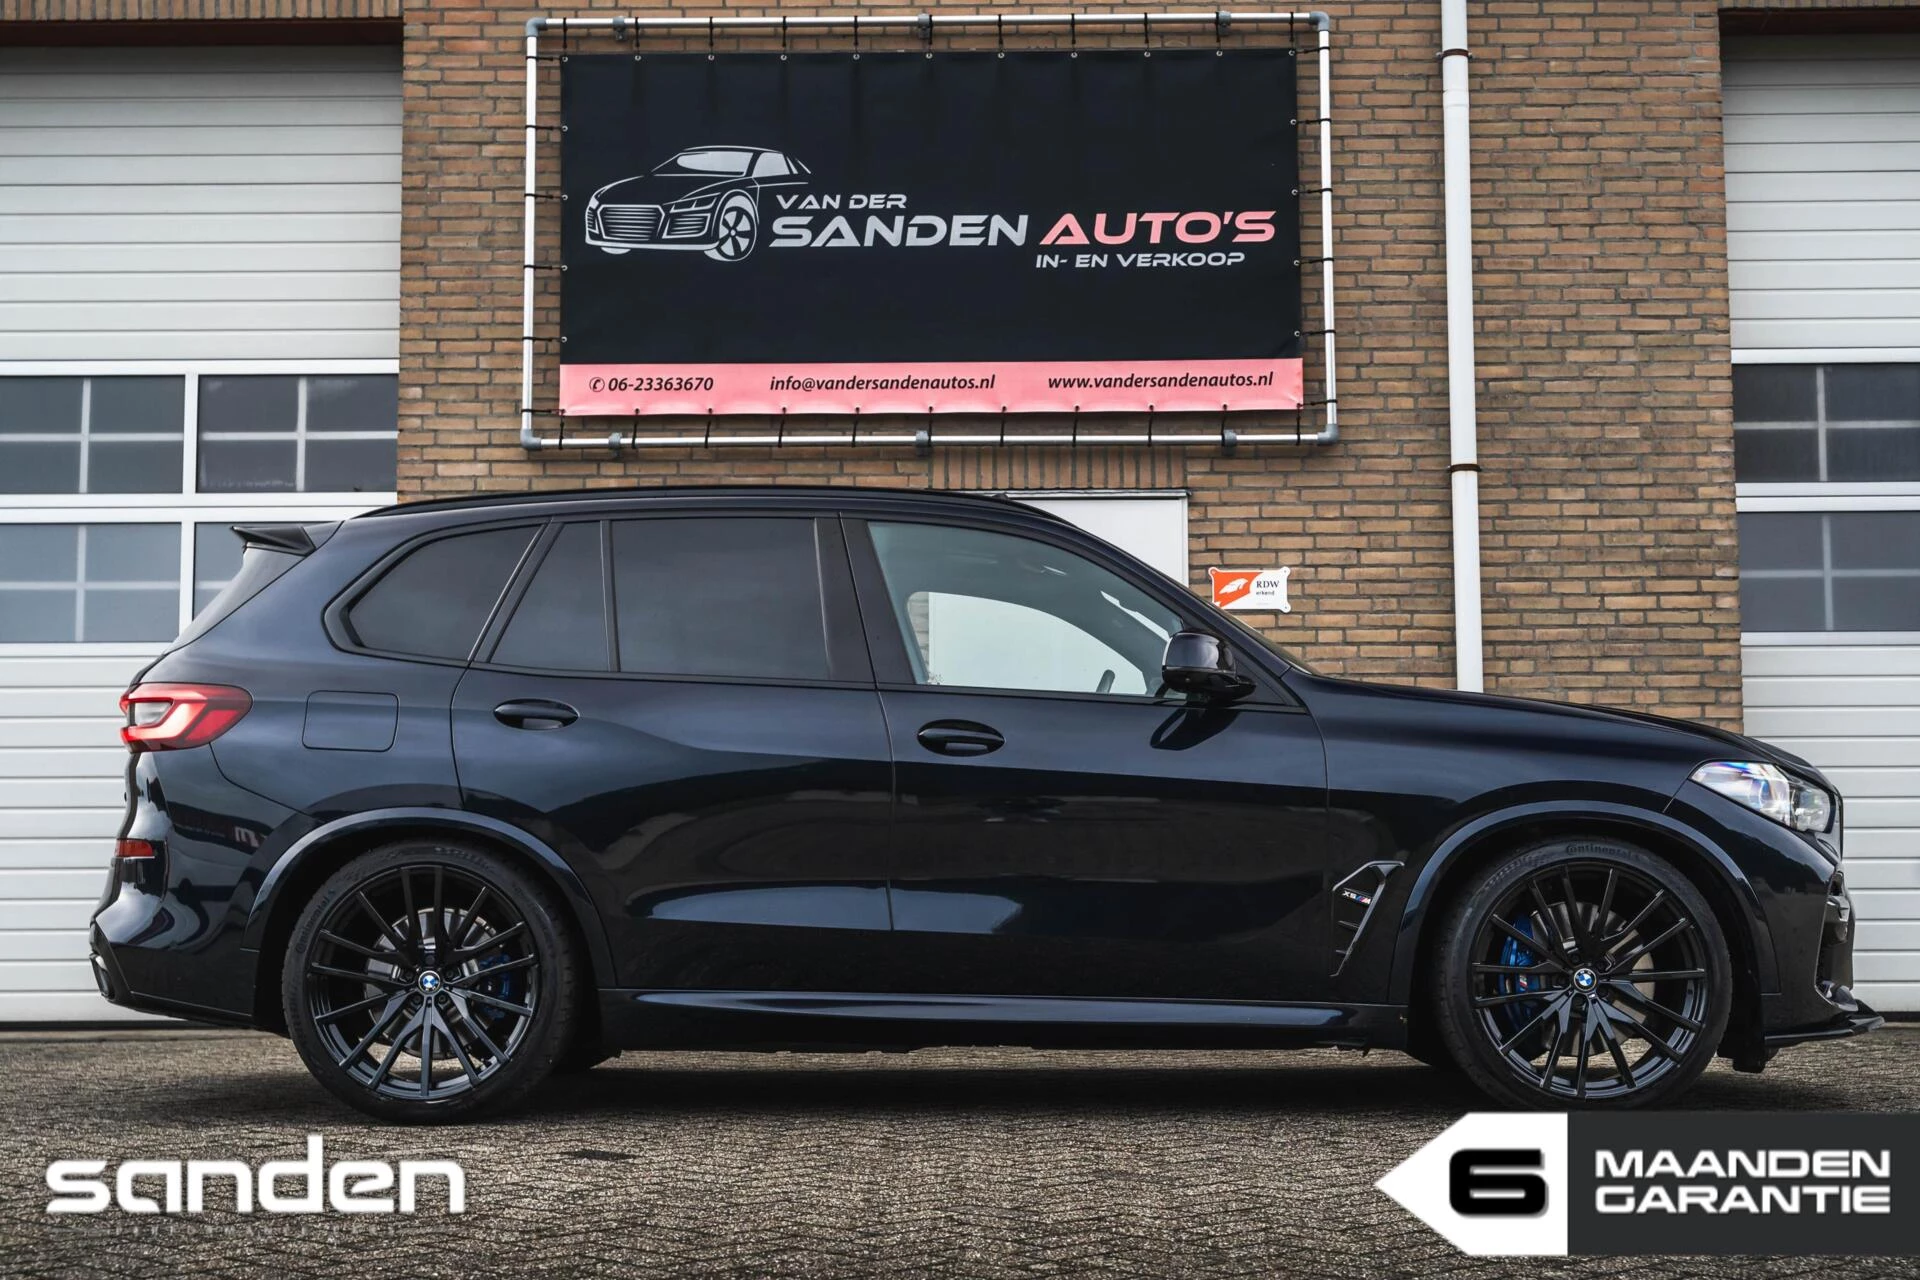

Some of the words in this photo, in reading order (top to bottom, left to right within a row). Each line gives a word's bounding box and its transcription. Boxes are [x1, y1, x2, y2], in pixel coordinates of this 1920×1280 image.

[775, 194, 841, 210] VAN
[848, 193, 907, 210] DER
[768, 214, 1029, 248] SANDEN
[1039, 210, 1277, 246] AUTO'S
[1035, 254, 1068, 269] IN-
[1074, 253, 1109, 268] EN
[1116, 251, 1246, 268] VERKOOP
[608, 376, 714, 392] 06-23363670
[769, 373, 995, 393] info@vandersandenautos.nl
[1048, 370, 1274, 389] www.vandersandenautos.nl
[1256, 580, 1279, 589] RDW
